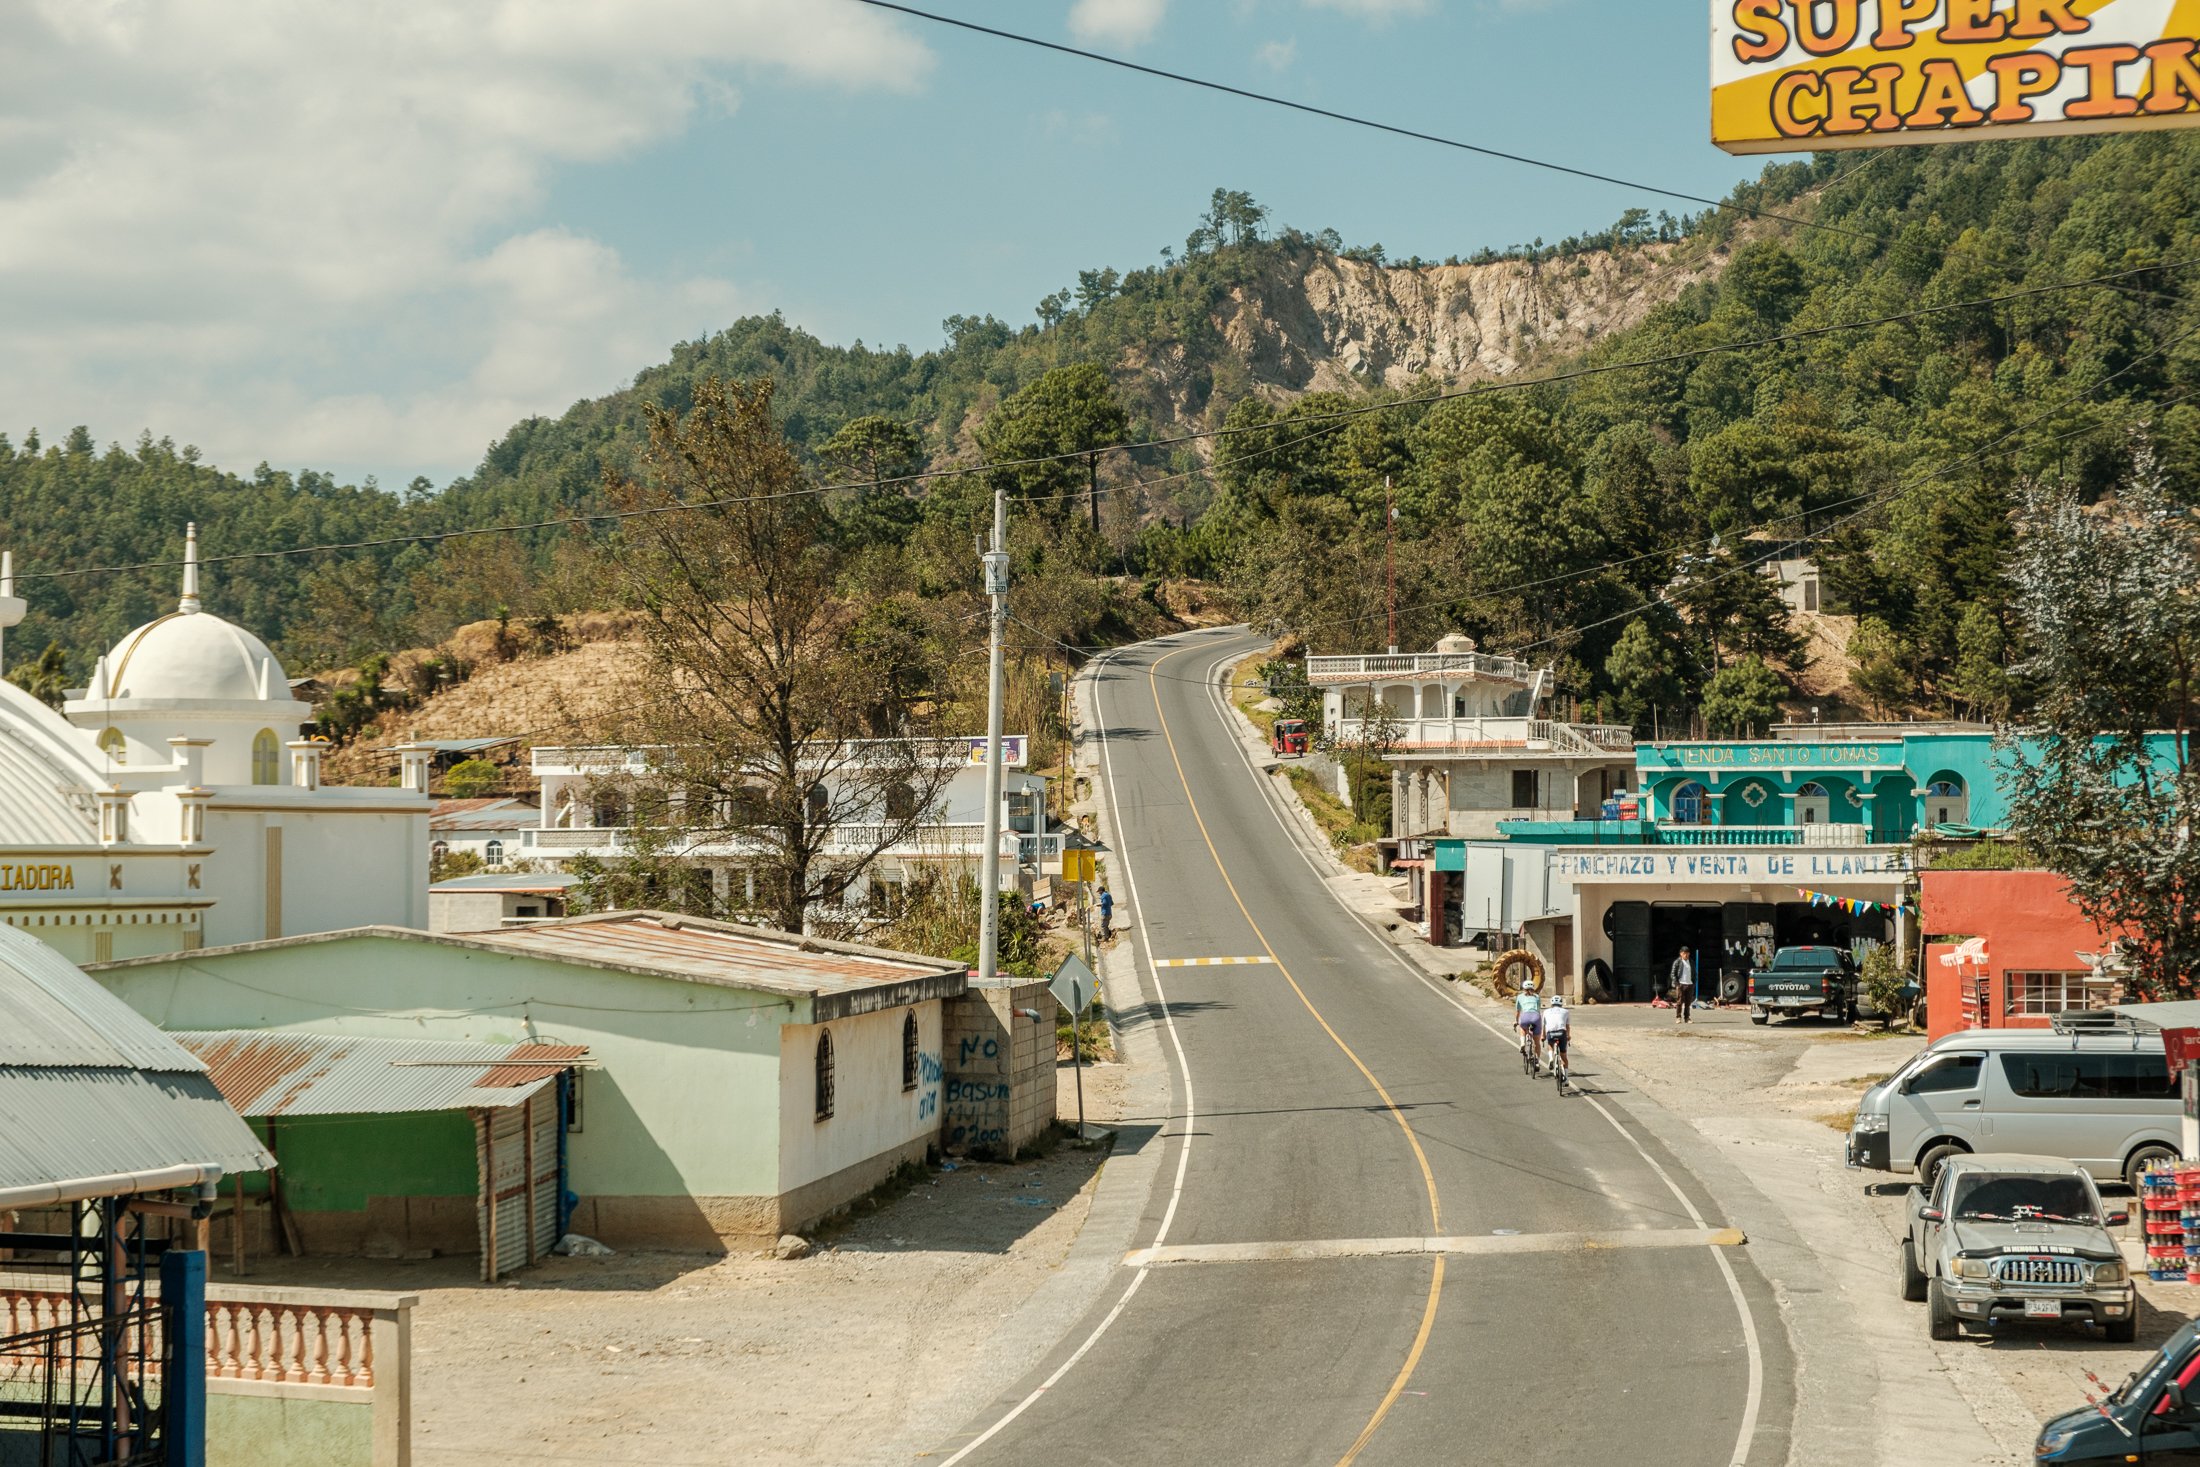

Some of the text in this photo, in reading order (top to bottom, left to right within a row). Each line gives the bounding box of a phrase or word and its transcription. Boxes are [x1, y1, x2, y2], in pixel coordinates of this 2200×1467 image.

[1674, 746, 1880, 764] TIENDA SANTO TOMAS
[1561, 856, 1654, 874] PINCHAZO
[1667, 856, 1677, 874] Y
[1687, 856, 1748, 874] VENTA
[1768, 856, 1794, 874] DE
[1775, 983, 1804, 991] TOYOTA
[960, 1034, 998, 1067] NO
